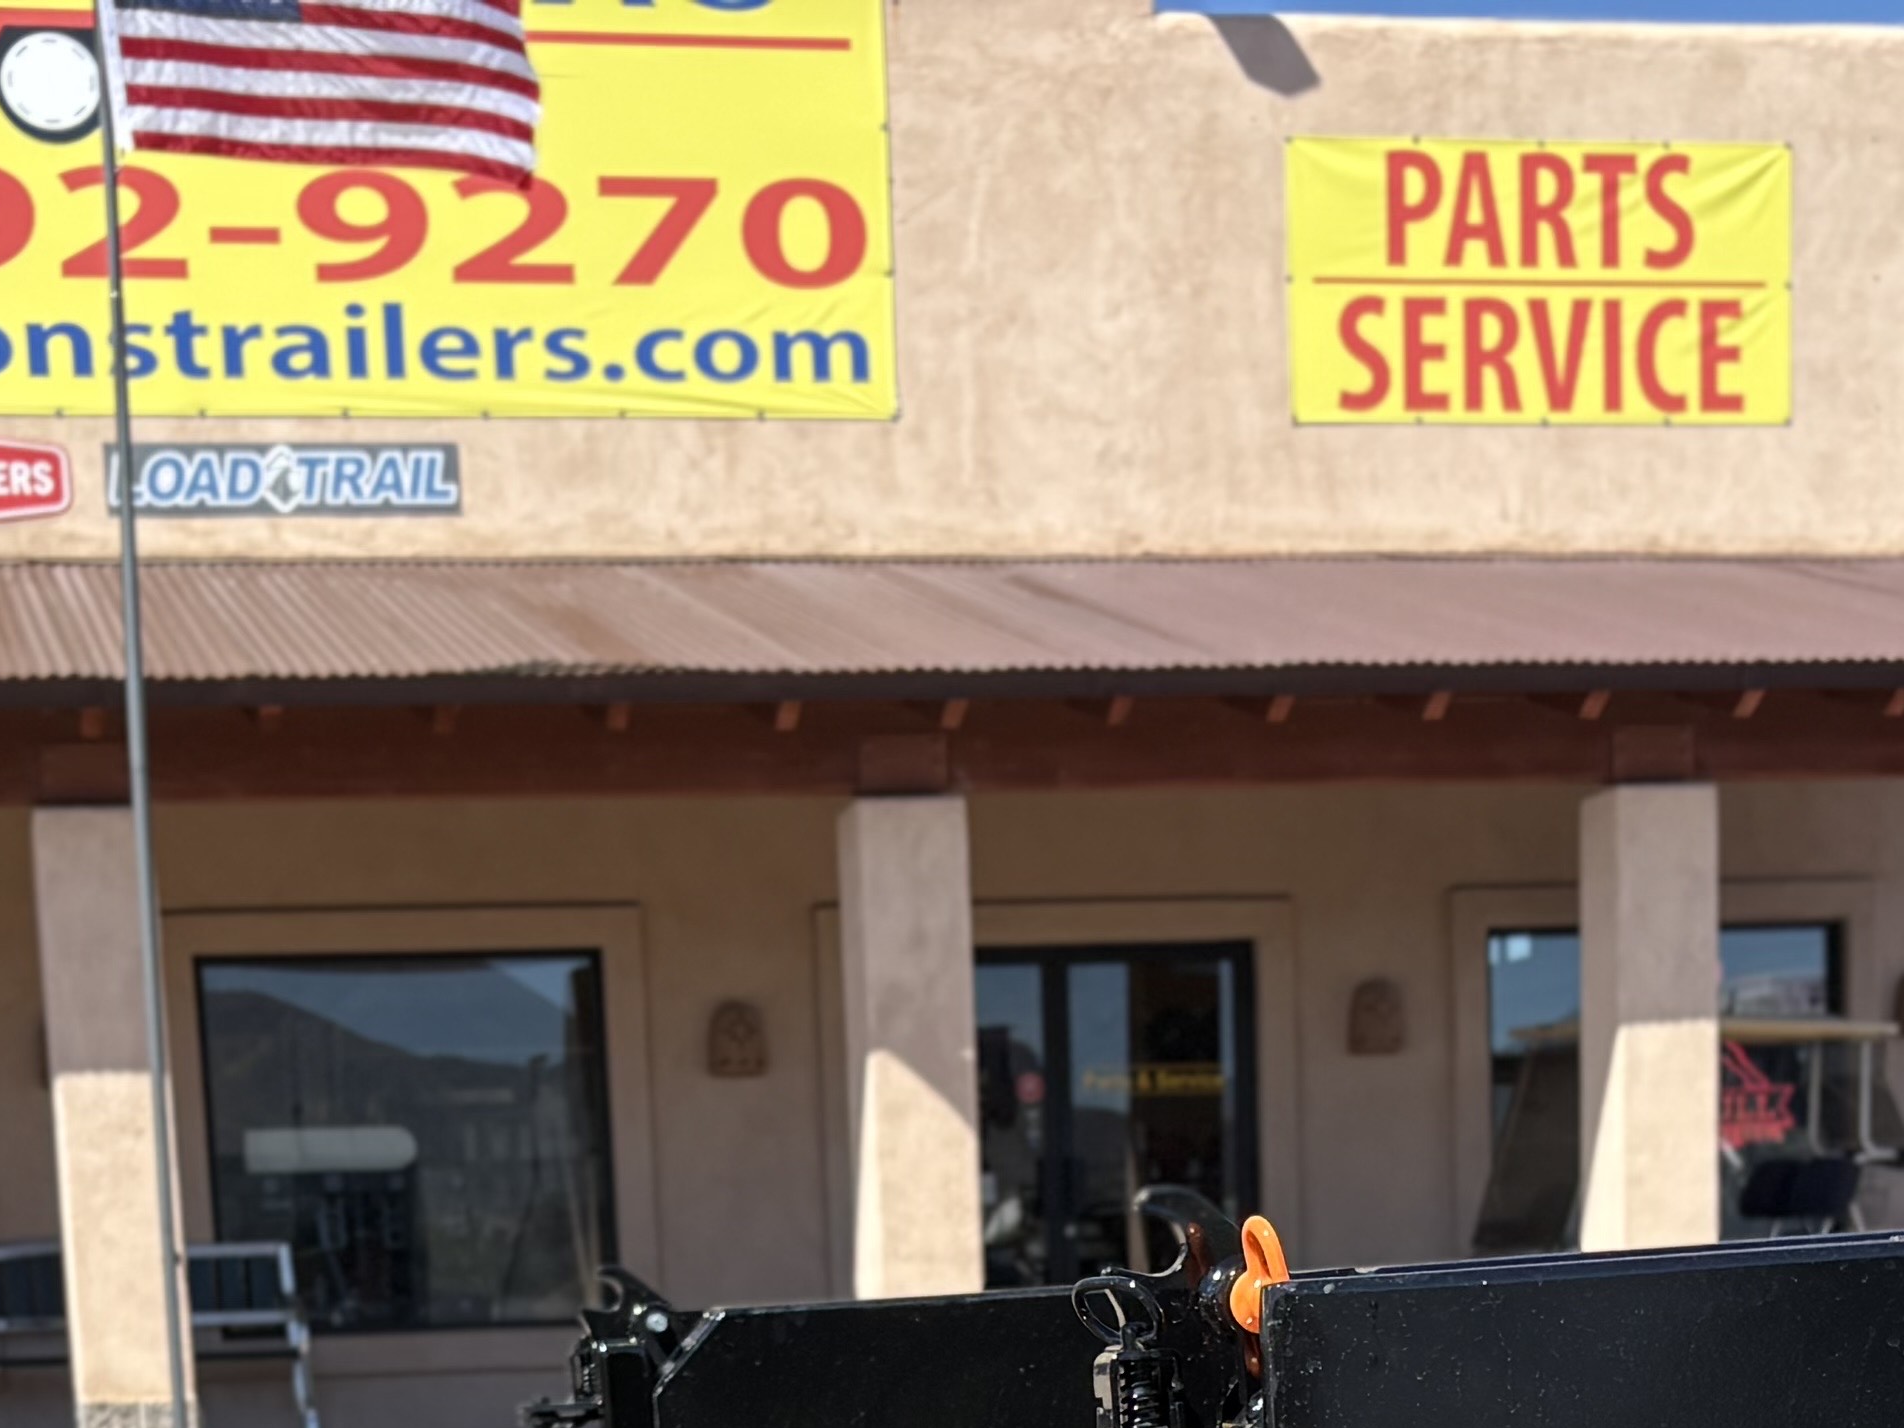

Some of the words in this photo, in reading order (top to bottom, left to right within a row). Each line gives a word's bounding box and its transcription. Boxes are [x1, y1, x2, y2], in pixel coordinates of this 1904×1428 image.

[1384, 149, 1696, 270] PARTS
[1337, 294, 1745, 414] SERVICE
[293, 449, 458, 507] TRAIL
